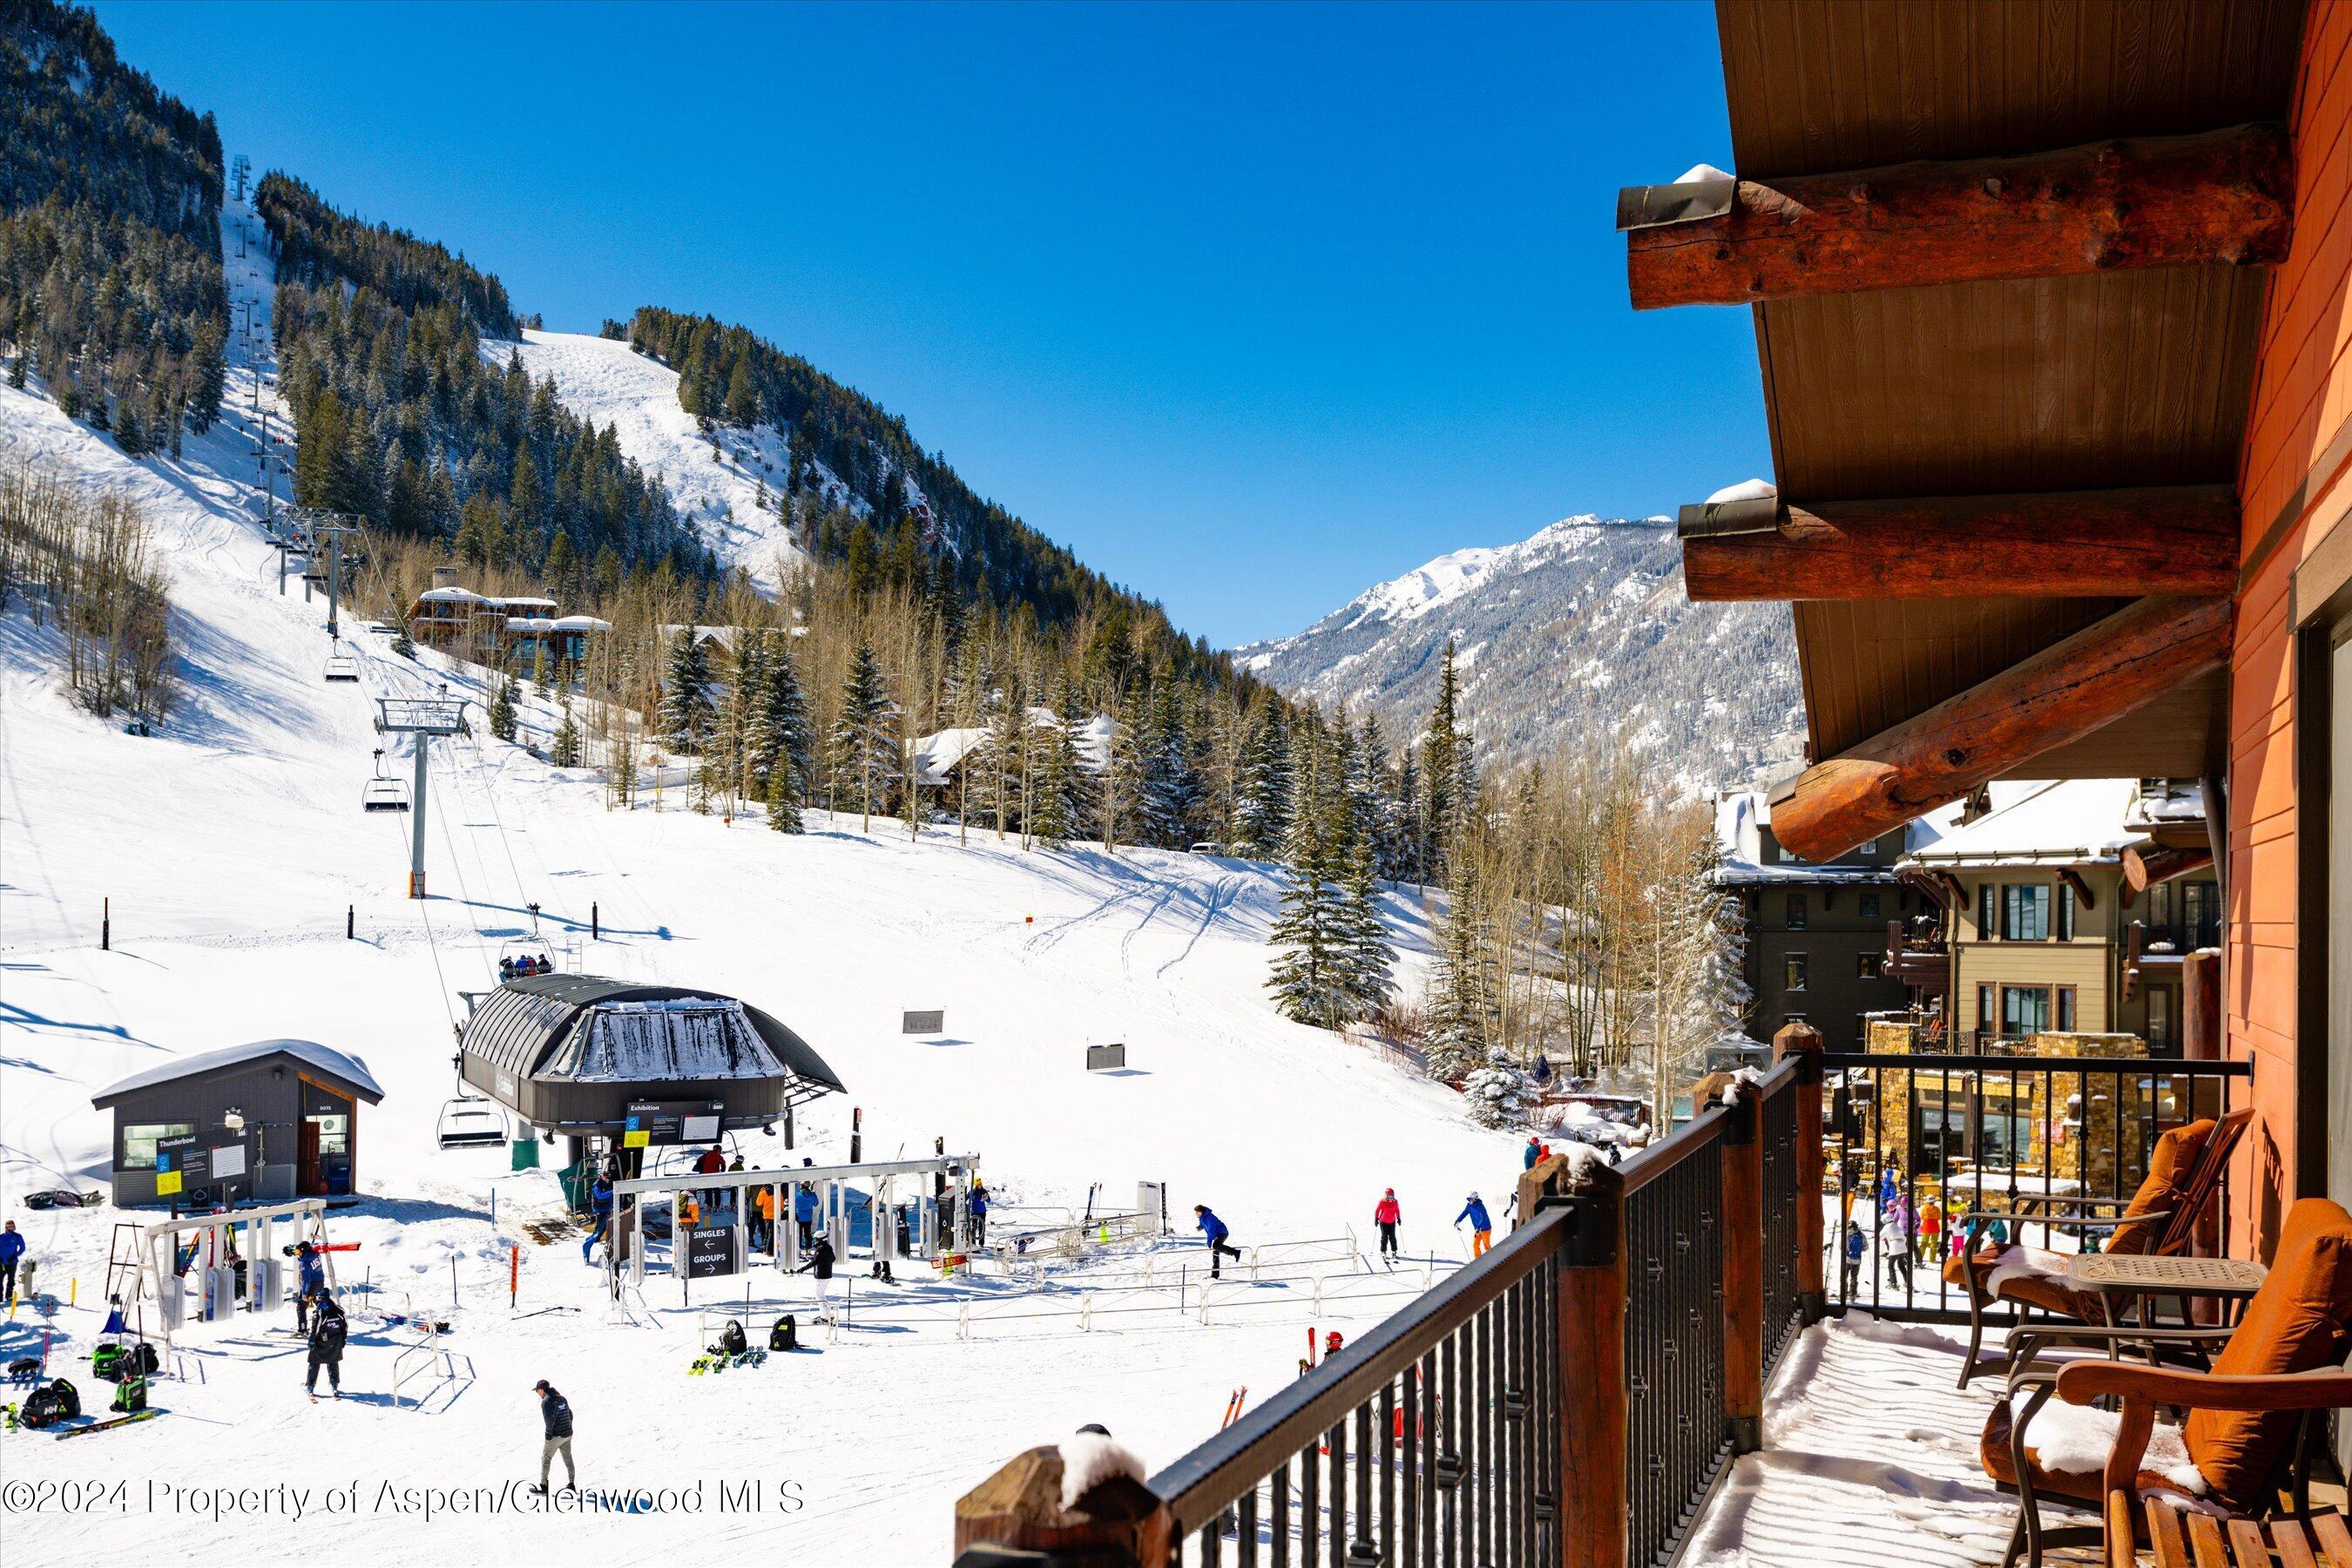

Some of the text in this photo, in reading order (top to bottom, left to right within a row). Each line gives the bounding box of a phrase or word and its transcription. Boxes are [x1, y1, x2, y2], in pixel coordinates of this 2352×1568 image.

[159, 1136, 196, 1148] Thunderbowl
[693, 1229, 726, 1239] SINGLES
[693, 1254, 727, 1263] GROUPS
[44, 1404, 58, 1416] HH
